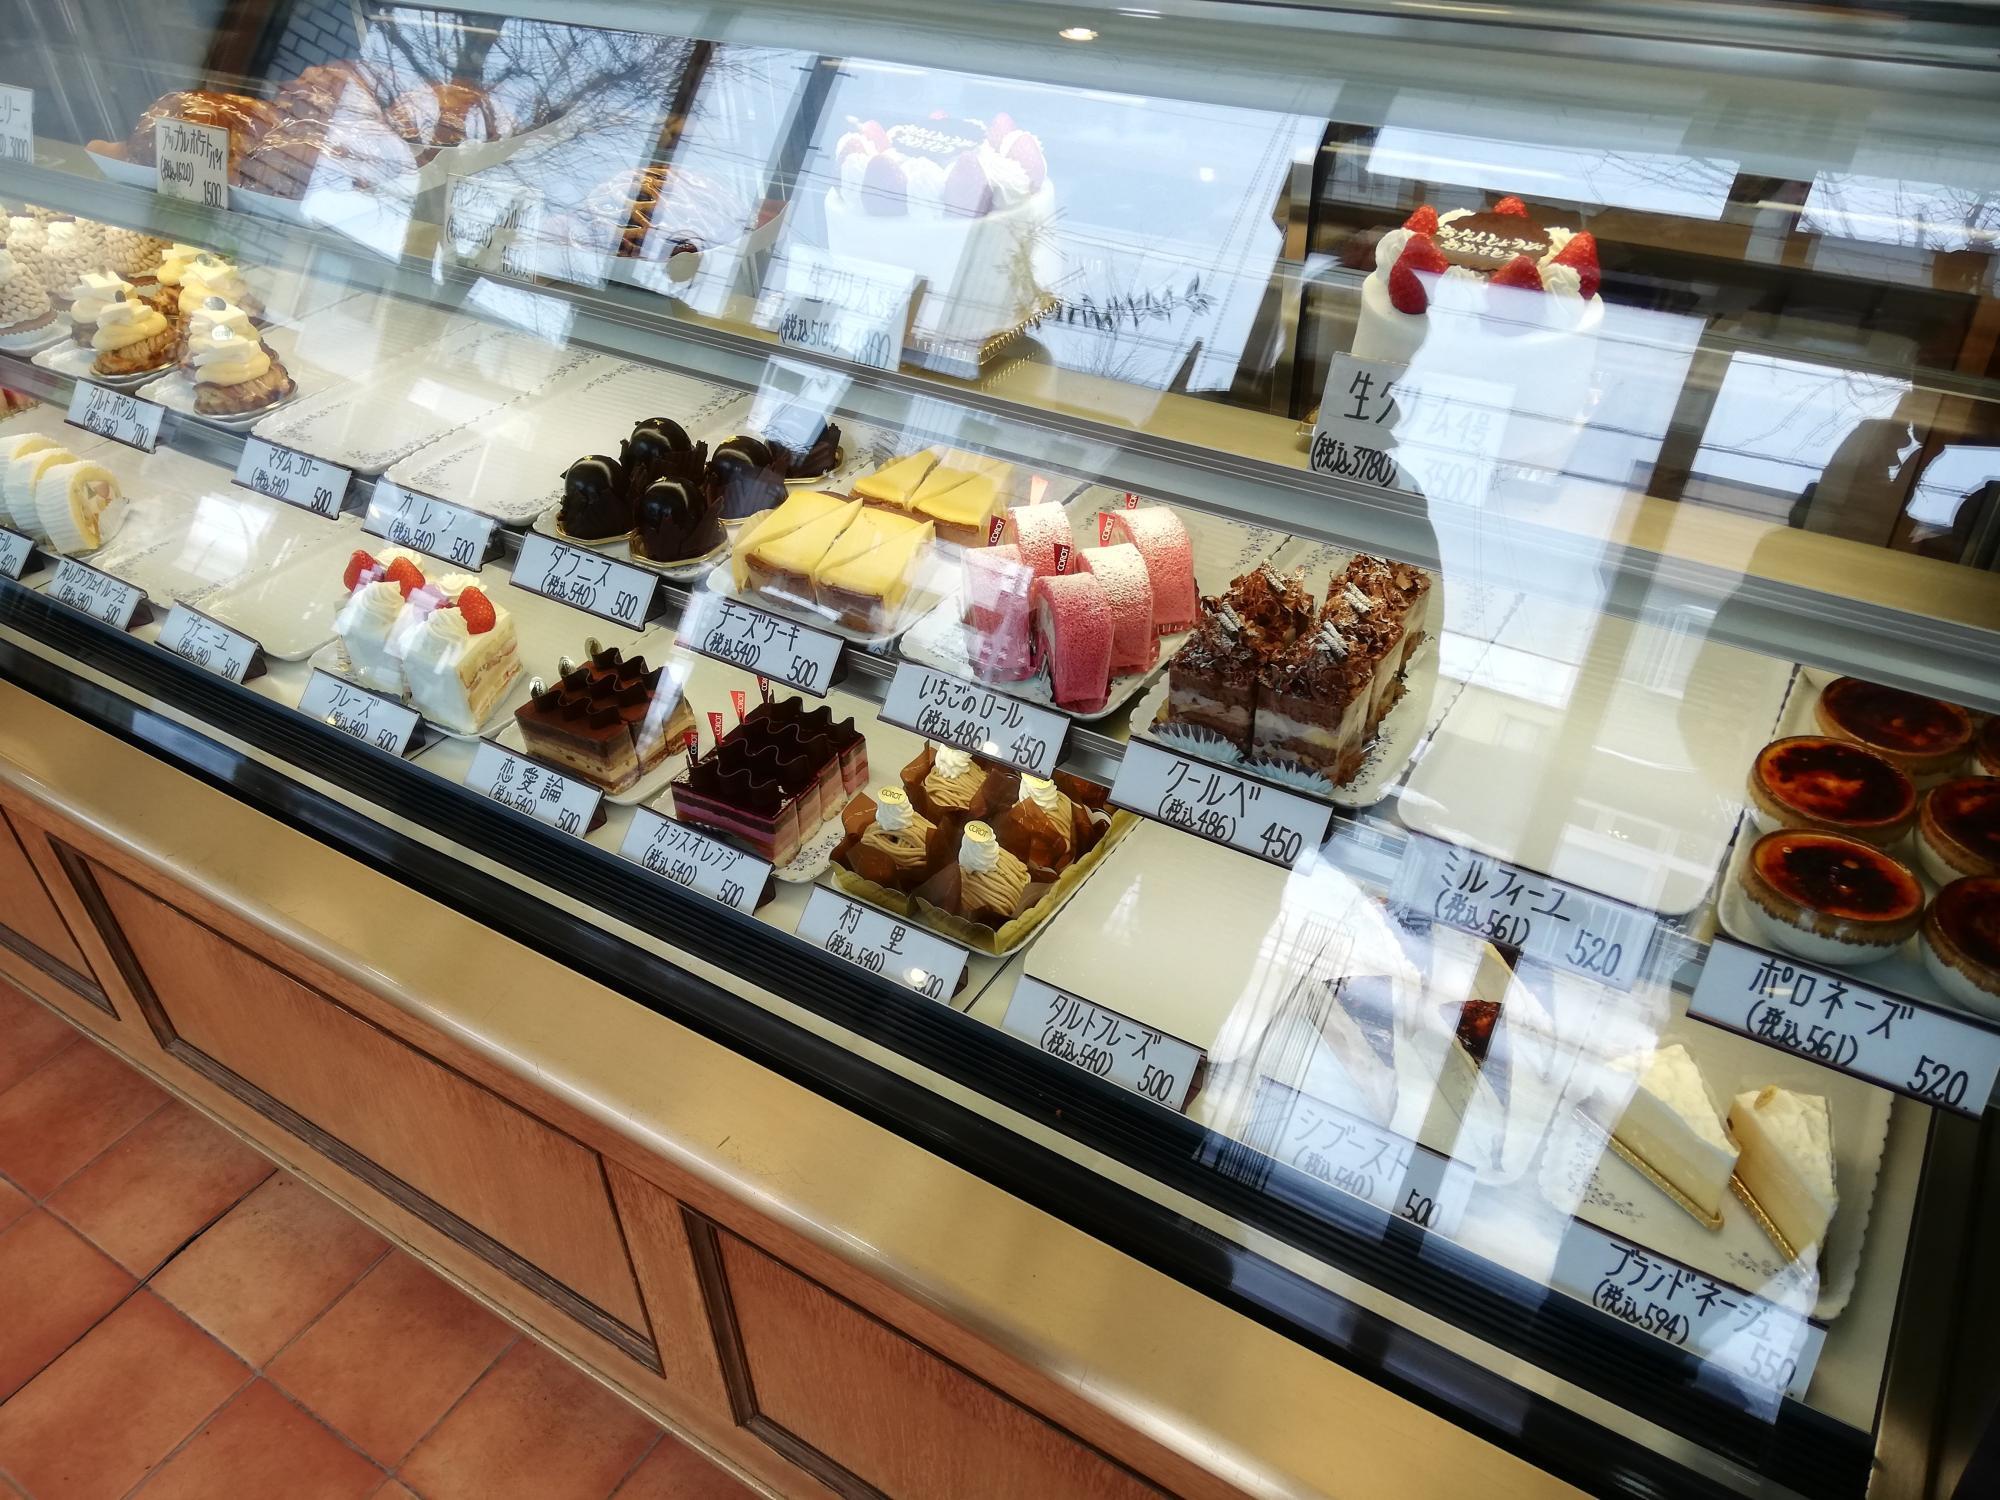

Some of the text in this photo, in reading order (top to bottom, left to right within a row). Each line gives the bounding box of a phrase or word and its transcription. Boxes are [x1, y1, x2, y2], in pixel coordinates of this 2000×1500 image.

[547, 545, 612, 587] ダフニス
[1056, 546, 1070, 572] COROT
[540, 573, 597, 609] (税込540)
[703, 628, 761, 667] (税込540)
[715, 603, 801, 651] チーズケーキ
[328, 683, 381, 719] フレーズ
[918, 674, 1024, 729] いちごのロール
[881, 789, 903, 801] COROT
[1157, 793, 1237, 843] (税込486)
[653, 820, 744, 873] カシスオレンジ
[968, 824, 989, 838] COROT
[1748, 958, 1914, 1040] ポロネーズ
[1046, 994, 1162, 1061] タルトフレーズ
[1746, 999, 1859, 1067] (税込561)
[1592, 1278, 1690, 1346] (税込594)
